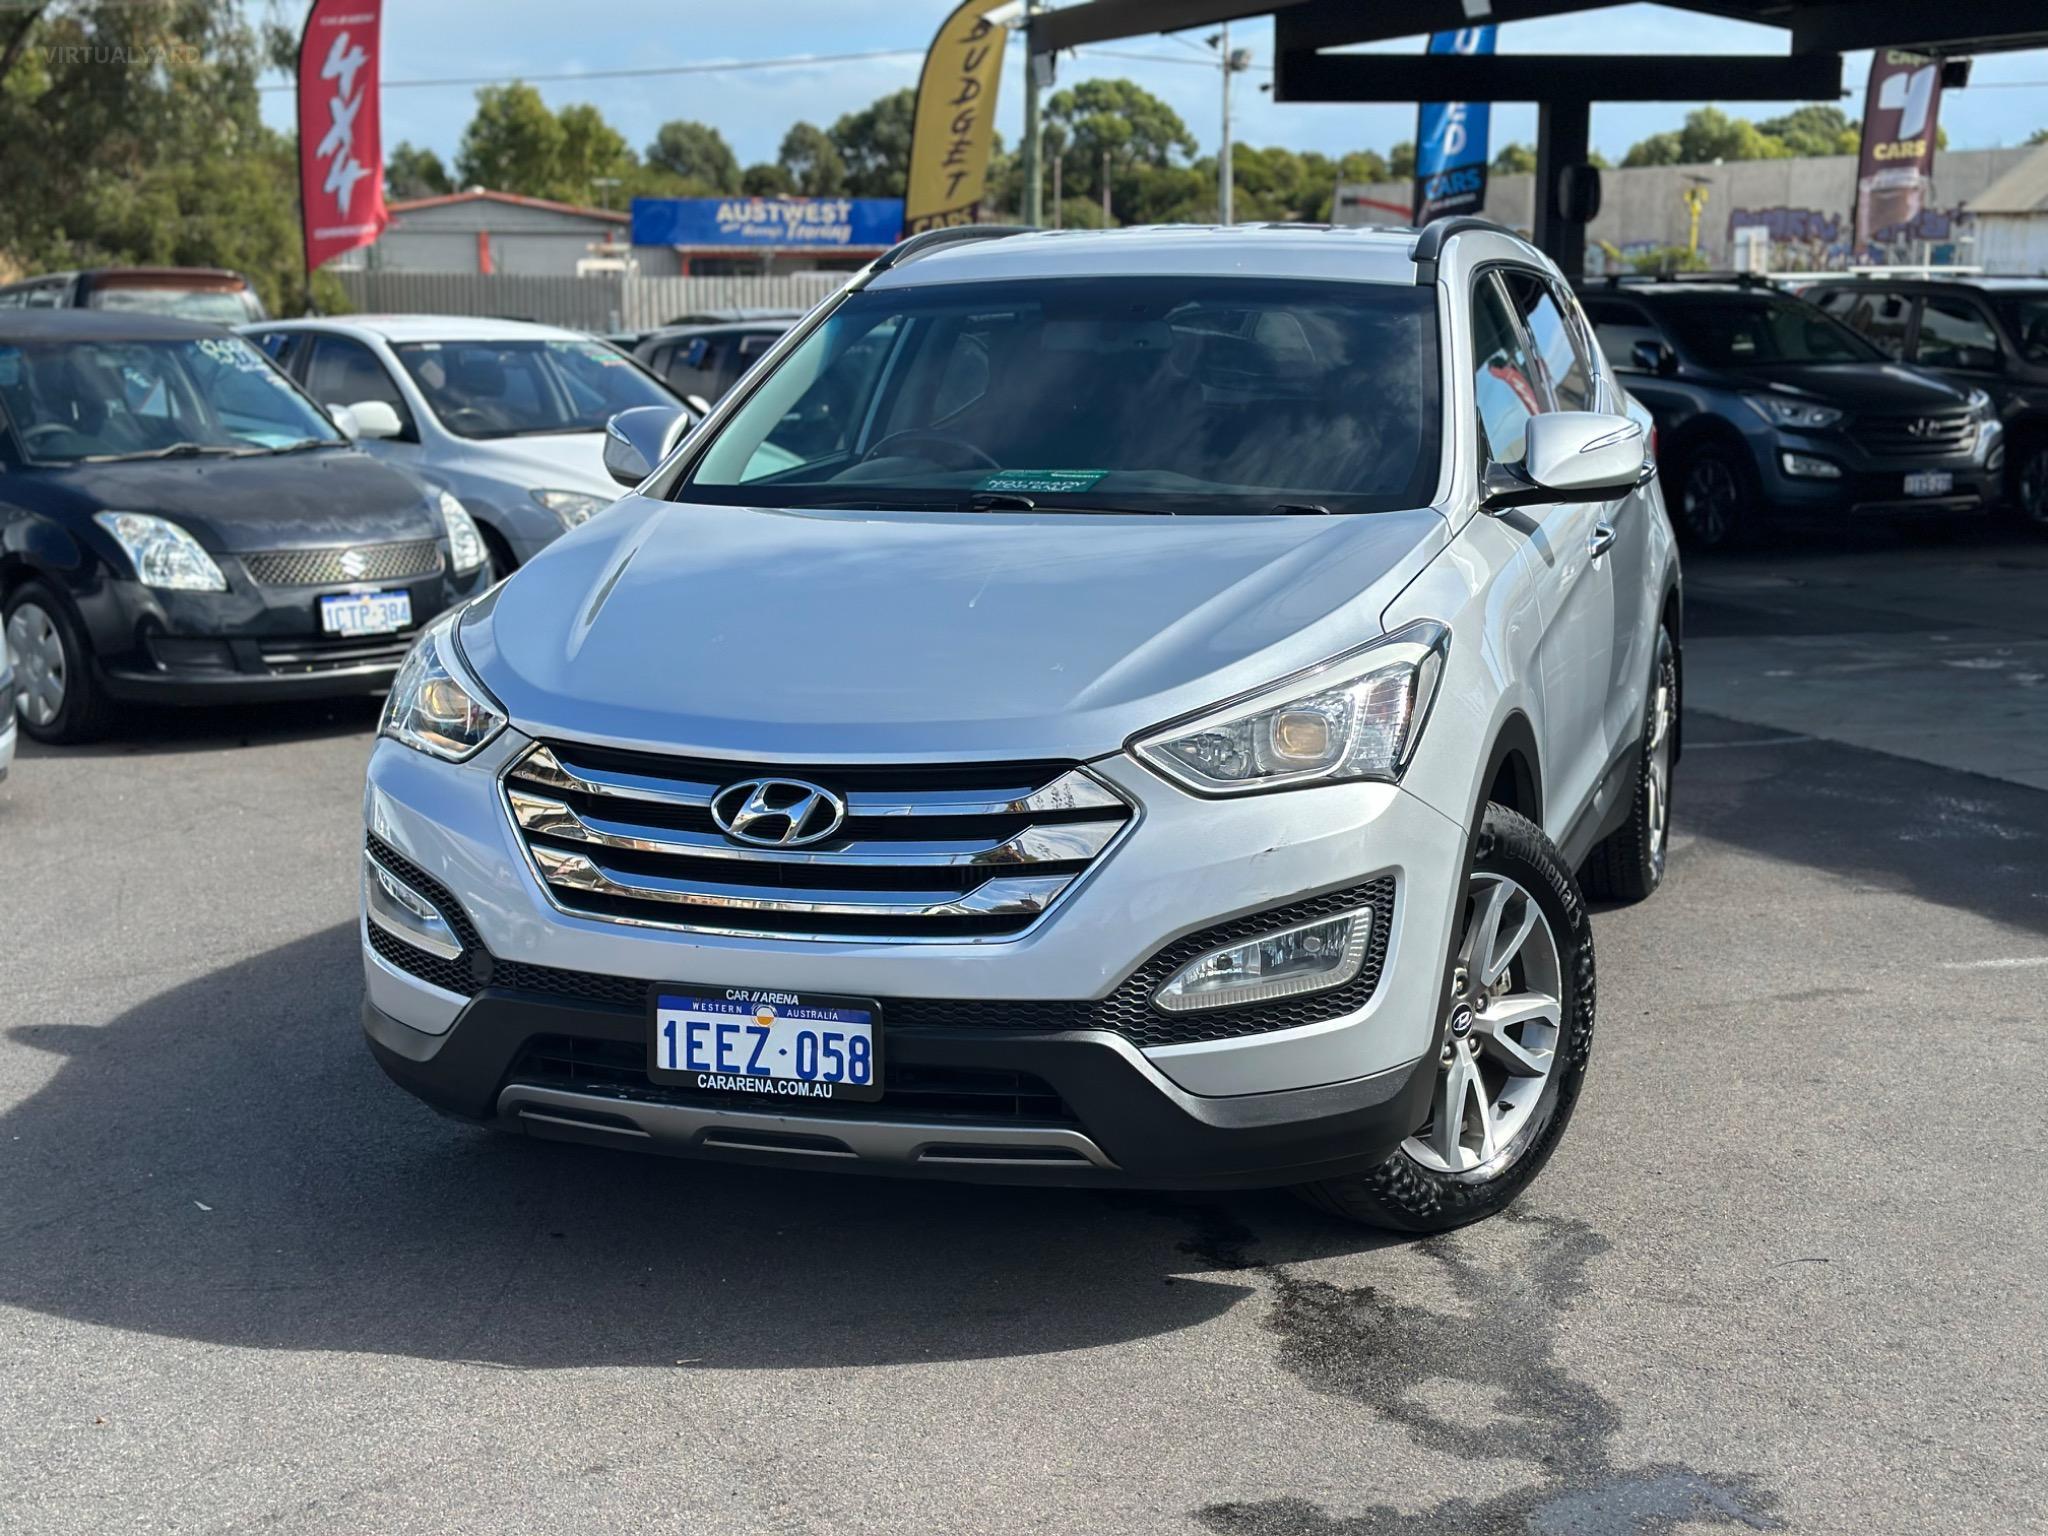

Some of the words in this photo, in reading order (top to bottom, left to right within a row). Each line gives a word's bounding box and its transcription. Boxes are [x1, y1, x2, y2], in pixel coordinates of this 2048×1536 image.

[1878, 64, 1936, 140] 4
[1872, 139, 1927, 161] CARS
[1424, 168, 1481, 201] CARS
[716, 201, 852, 224] AUSTWEST
[725, 989, 750, 1002] CAR
[692, 1001, 743, 1014] WESTERN
[786, 1008, 839, 1021] AUSTRALIA
[697, 1073, 834, 1099] CARARENA.COM.AU
